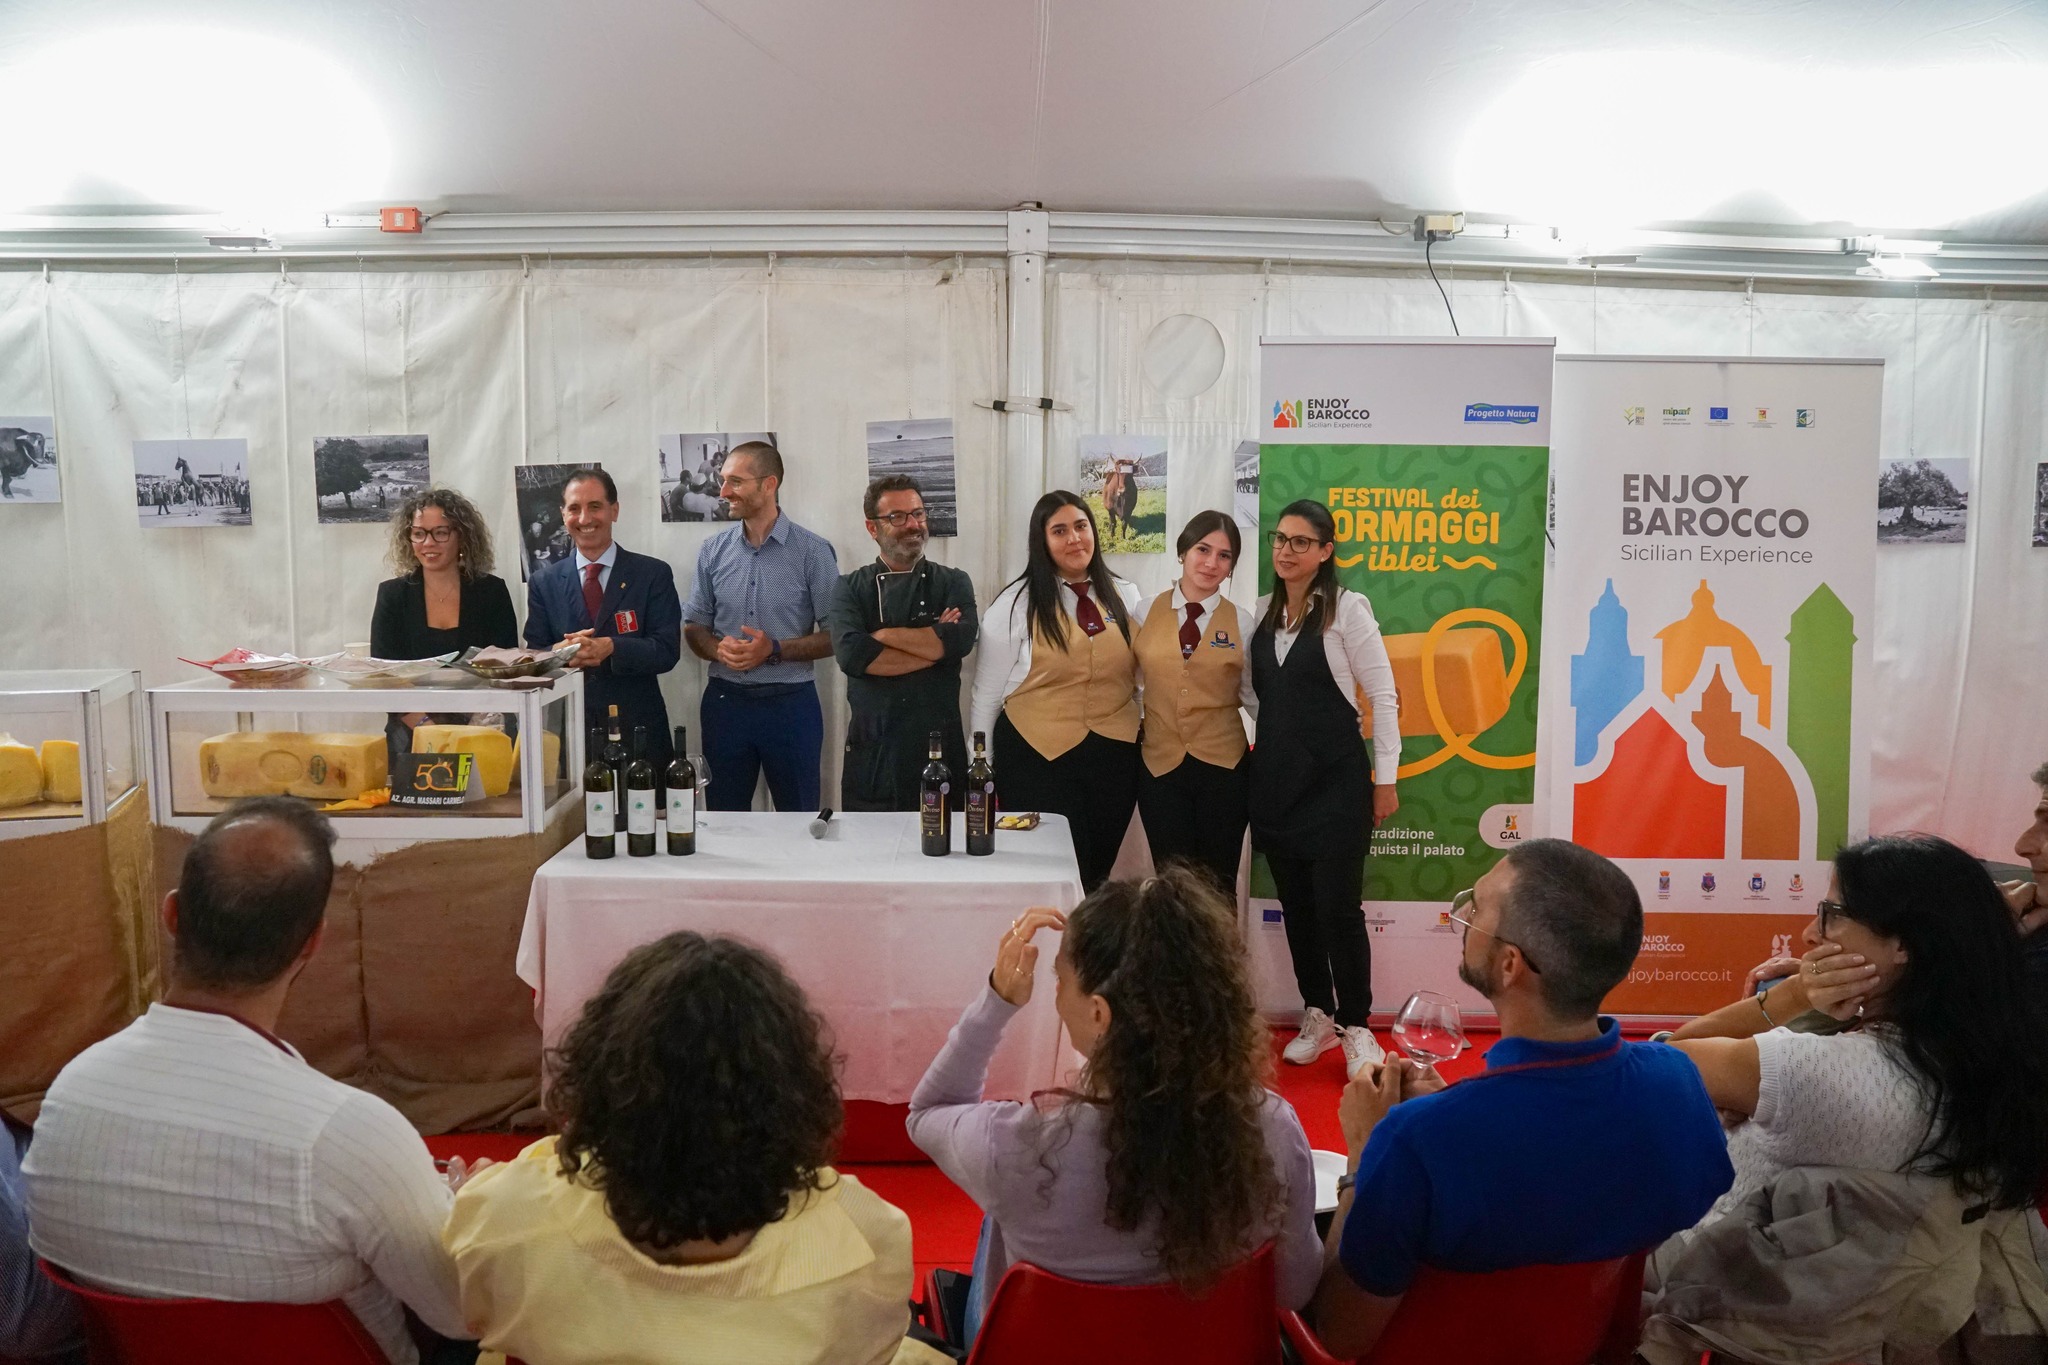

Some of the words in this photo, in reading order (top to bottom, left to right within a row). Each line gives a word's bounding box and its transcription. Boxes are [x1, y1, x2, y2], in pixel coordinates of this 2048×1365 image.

[1307, 398, 1350, 409] ENJOY
[1307, 409, 1370, 420] BAROCCO
[1467, 409, 1505, 419] Progetto
[1506, 409, 1536, 418] Natura
[1307, 421, 1332, 429] Sicilian
[1333, 421, 1373, 430] Experience
[1623, 473, 1749, 504] ENJOY
[1328, 487, 1433, 509] FESTIVAL
[1440, 488, 1482, 509] dei
[1331, 509, 1500, 544] ORMAGGI
[1622, 506, 1810, 539] BAROCCO
[1368, 544, 1440, 572] iblei
[1620, 544, 1692, 561] Sicilian
[1700, 545, 1813, 565] Experience
[391, 794, 401, 803] AZ.
[402, 796, 416, 804] AGR.
[417, 796, 442, 805] MASSARI
[1500, 831, 1521, 840] GAL
[1369, 843, 1409, 857] quista
[1412, 843, 1420, 855] il
[1423, 843, 1465, 858] palato
[1642, 935, 1670, 943] NJOY
